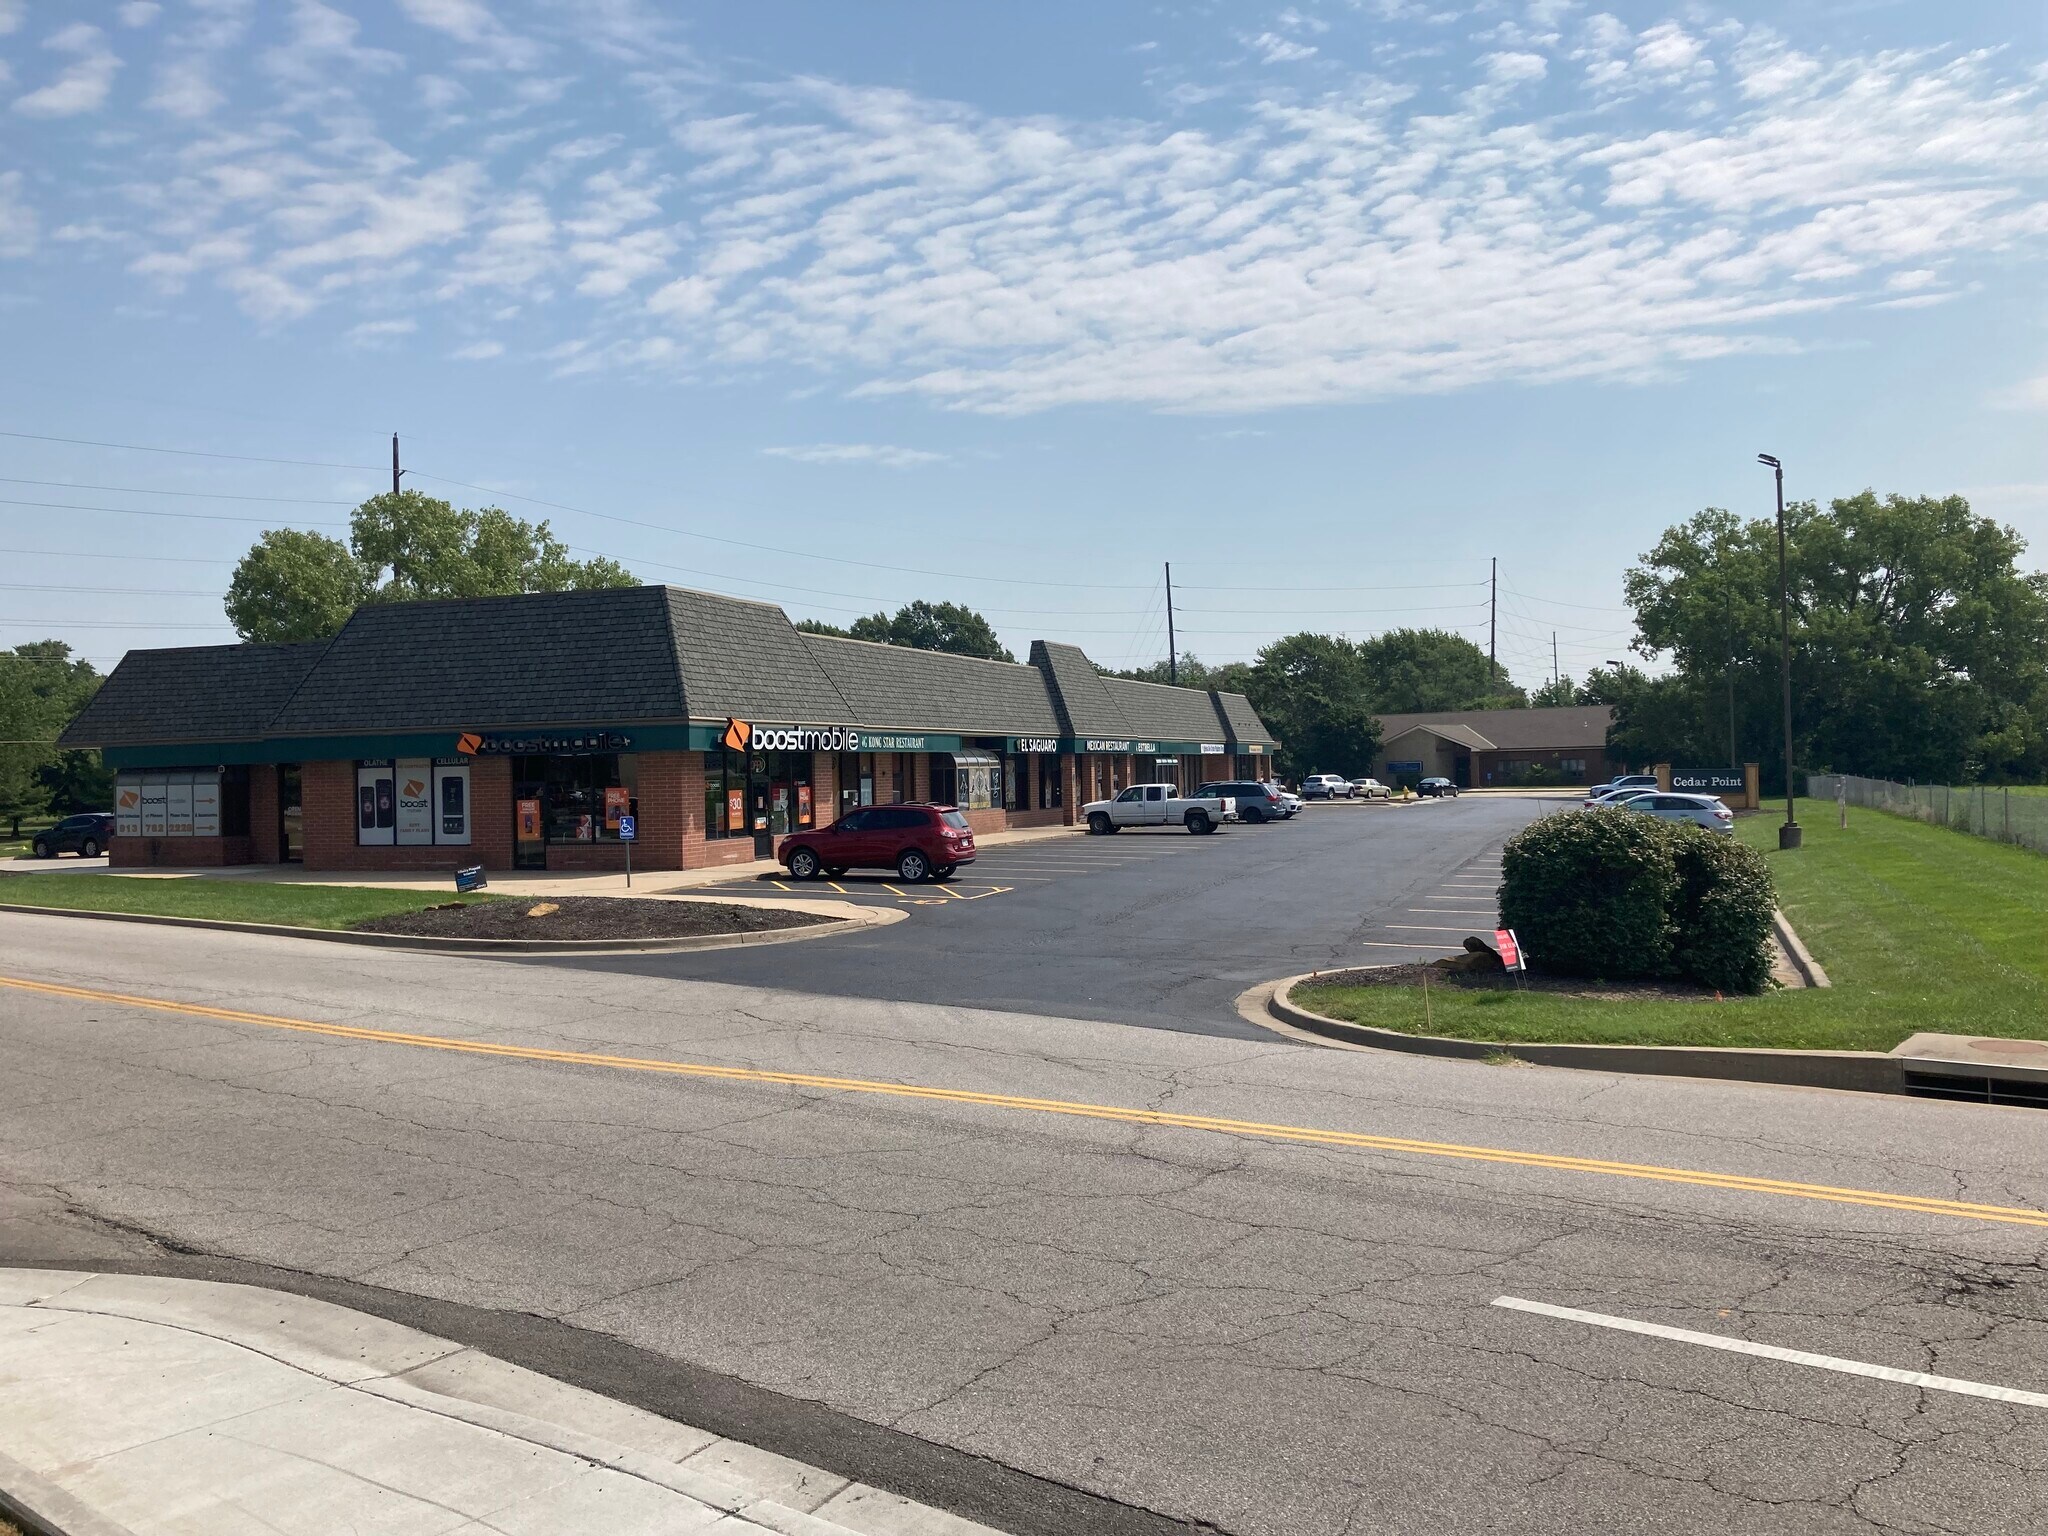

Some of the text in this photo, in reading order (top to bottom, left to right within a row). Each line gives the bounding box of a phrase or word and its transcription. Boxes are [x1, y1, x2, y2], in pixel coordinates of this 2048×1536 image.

[752, 724, 859, 751] boostmobile
[868, 736, 882, 749] KONG
[883, 737, 895, 749] STAR
[895, 737, 925, 749] RESTAURANT
[1021, 738, 1057, 752] EL SAGUARO
[1086, 740, 1105, 751] MEXICAN
[1105, 741, 1130, 751] RESTAURANT
[1138, 743, 1156, 752] ESTRELLA
[436, 757, 468, 765] CELLULAR
[1673, 776, 1742, 787] Cedar Point
[400, 800, 428, 808] boost
